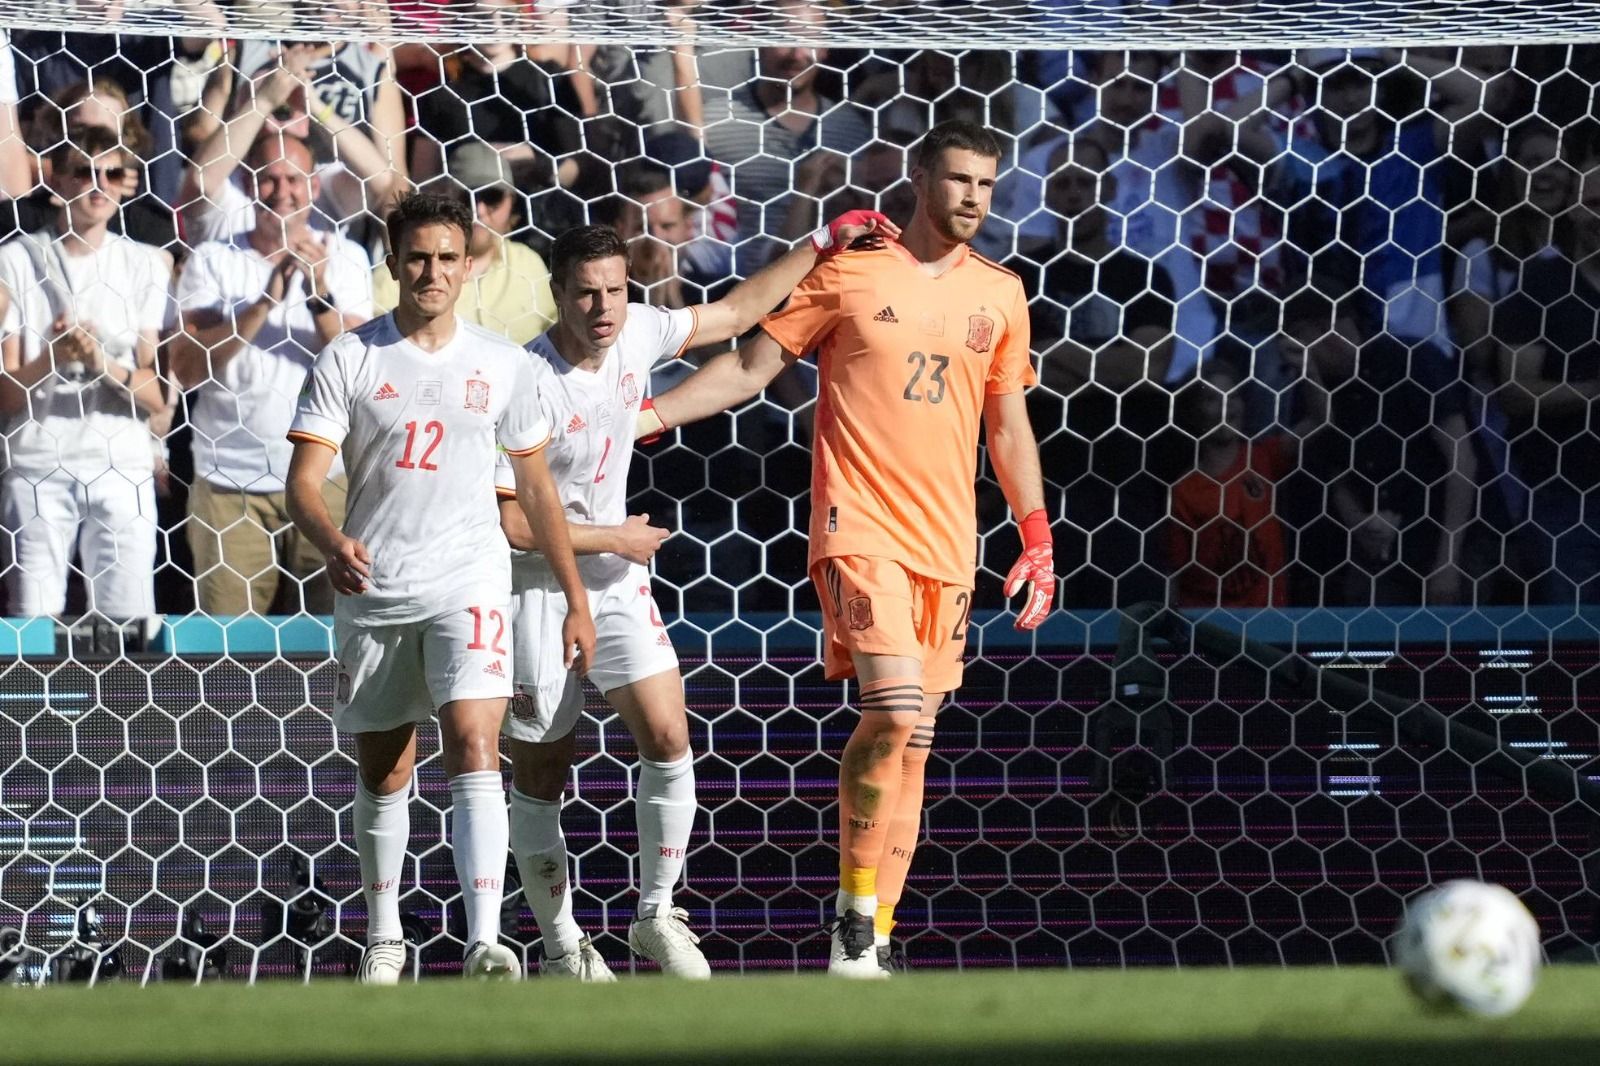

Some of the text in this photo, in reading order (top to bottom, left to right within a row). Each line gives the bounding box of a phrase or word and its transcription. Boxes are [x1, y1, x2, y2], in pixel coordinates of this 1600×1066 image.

[373, 393, 400, 401] adidas
[903, 351, 950, 404] 23
[395, 421, 444, 471] 12
[466, 606, 506, 656] 12
[639, 585, 664, 628] 2
[951, 592, 971, 641] 2
